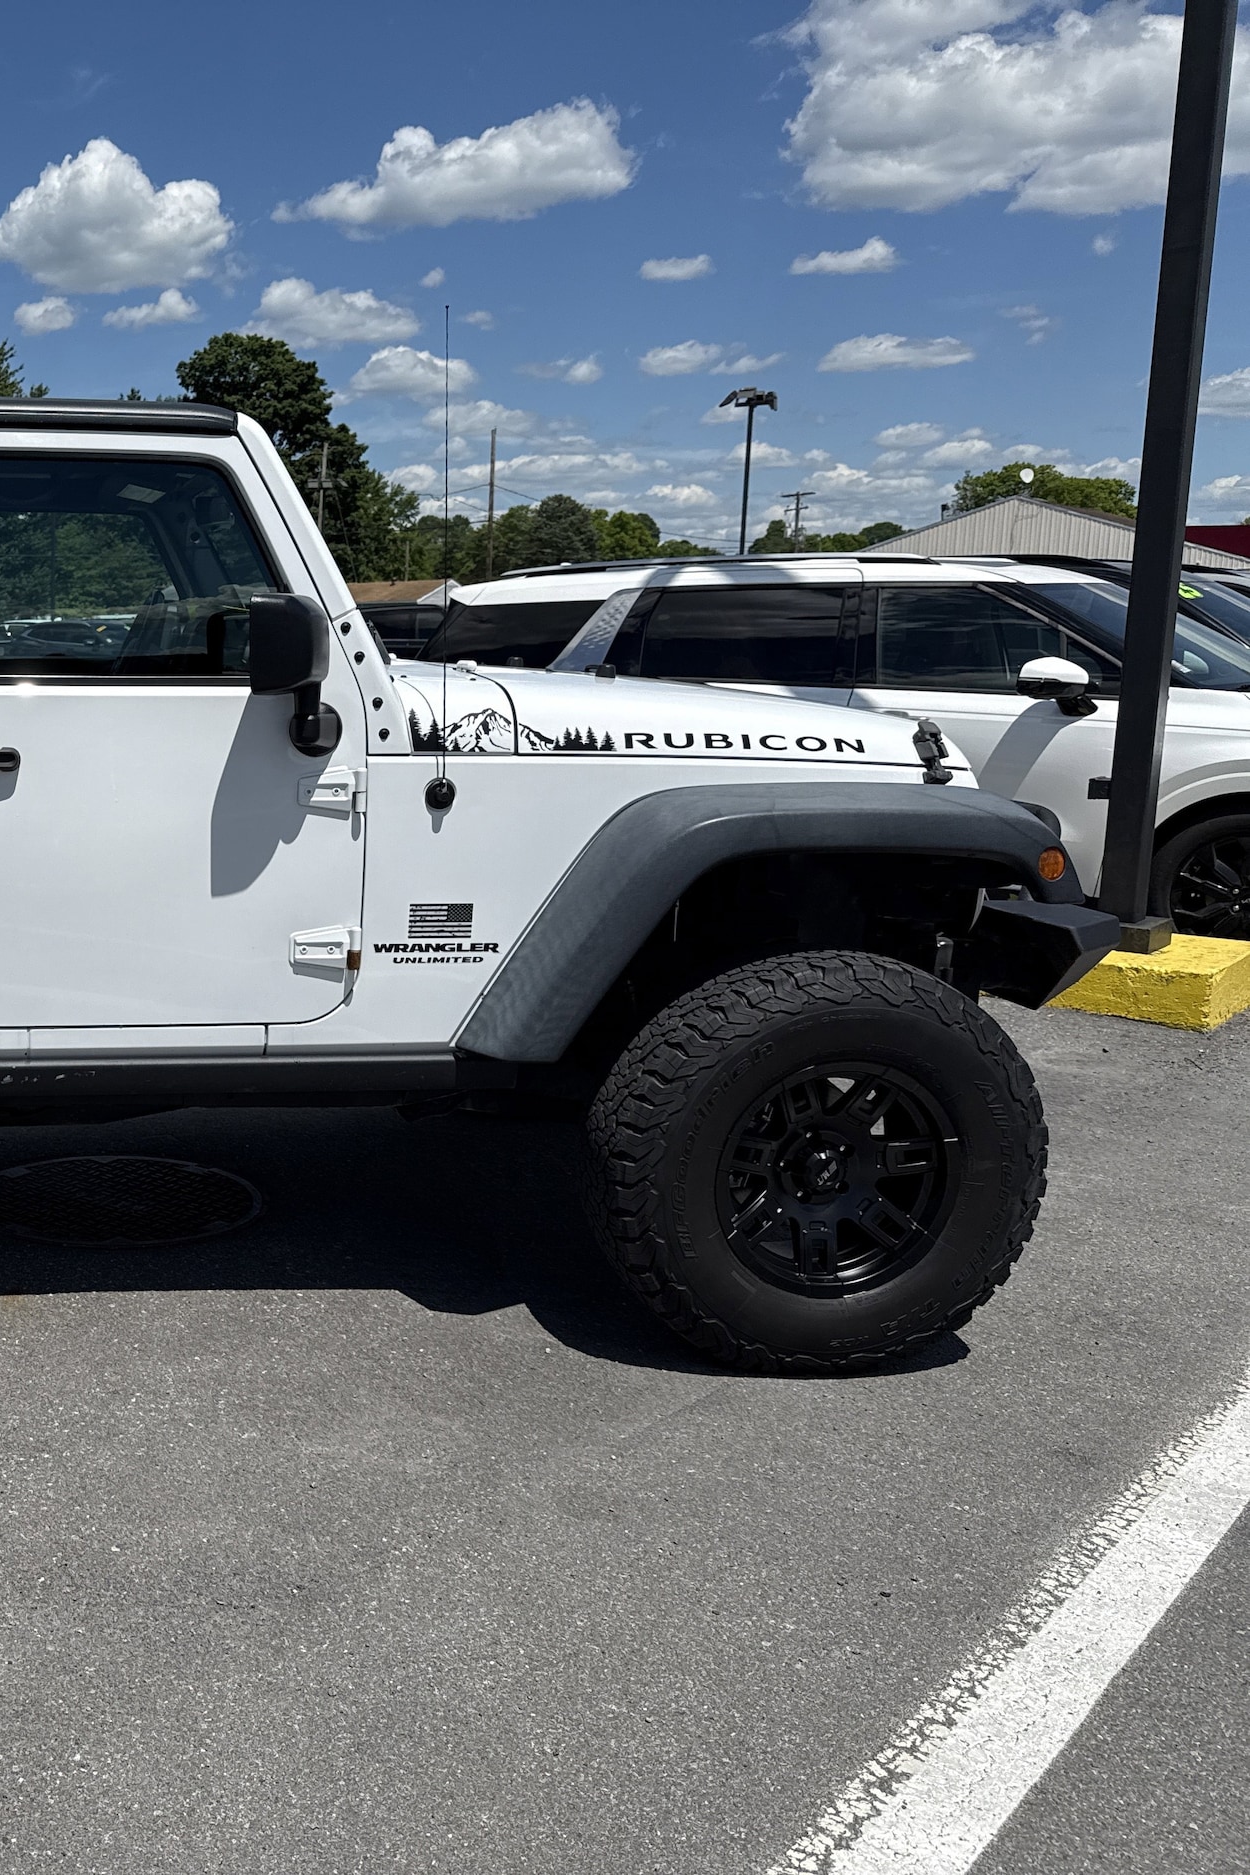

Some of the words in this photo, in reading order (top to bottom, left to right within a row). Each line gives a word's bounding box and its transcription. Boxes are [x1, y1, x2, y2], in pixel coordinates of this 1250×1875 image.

[624, 732, 866, 753] RUBICON
[373, 942, 500, 953] WRANGLER
[393, 956, 484, 964] UNLIMITED
